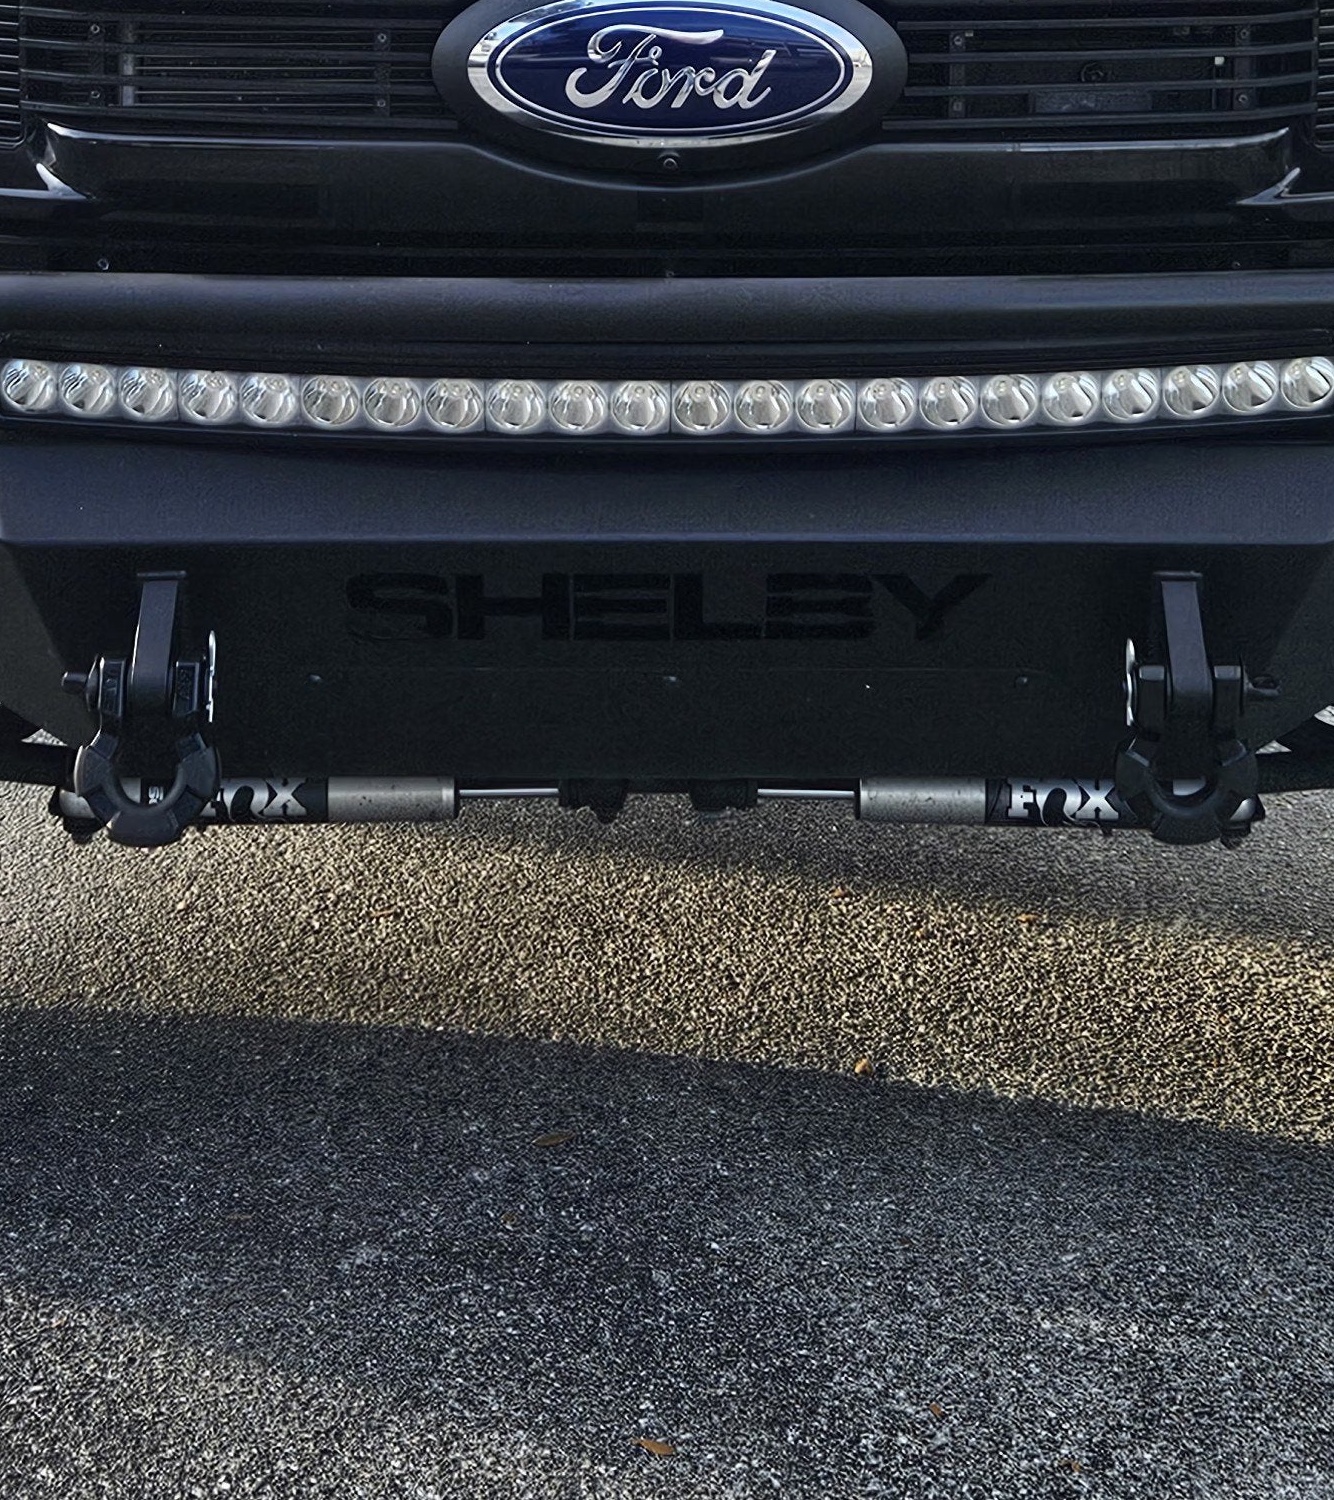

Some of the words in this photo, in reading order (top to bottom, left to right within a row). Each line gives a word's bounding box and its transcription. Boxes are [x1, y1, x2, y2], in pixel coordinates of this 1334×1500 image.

[566, 23, 776, 110] Ford
[345, 572, 993, 642] SHELBY
[1007, 778, 1119, 826] FOX
